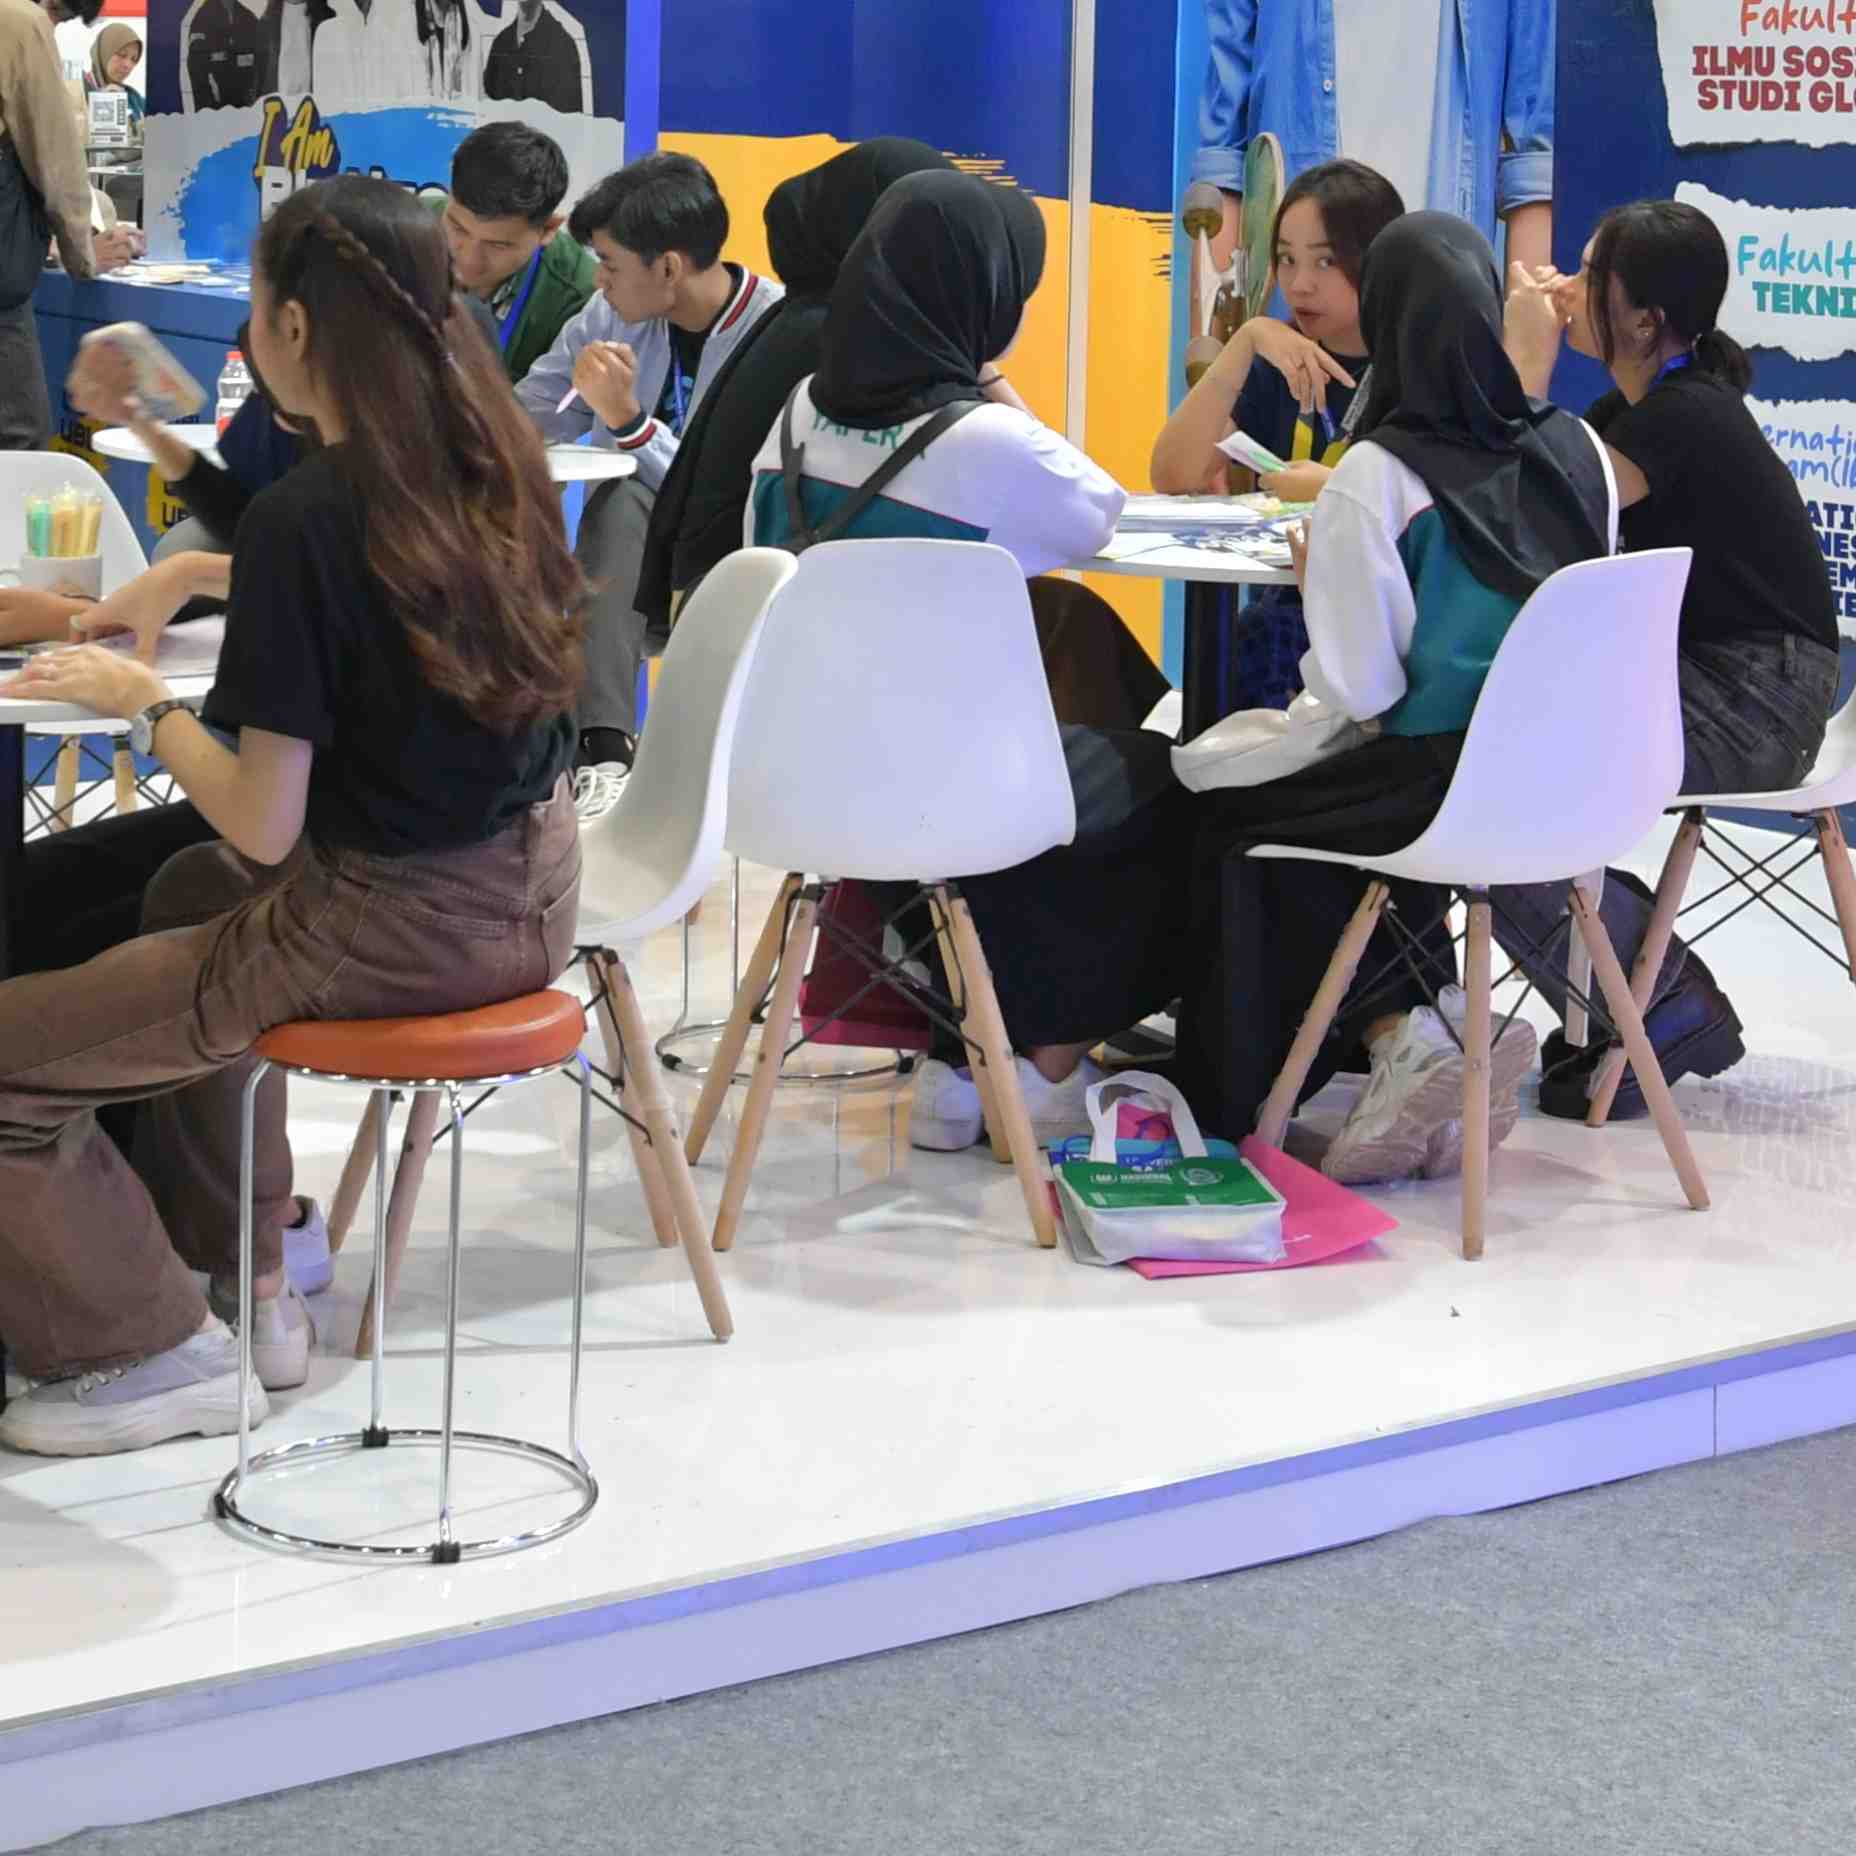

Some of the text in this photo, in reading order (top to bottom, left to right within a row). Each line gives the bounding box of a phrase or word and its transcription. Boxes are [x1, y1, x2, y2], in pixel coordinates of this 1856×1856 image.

[1692, 46, 1776, 78] ILMU
[1697, 79, 1801, 112] STUDI
[255, 100, 336, 177] I Am
